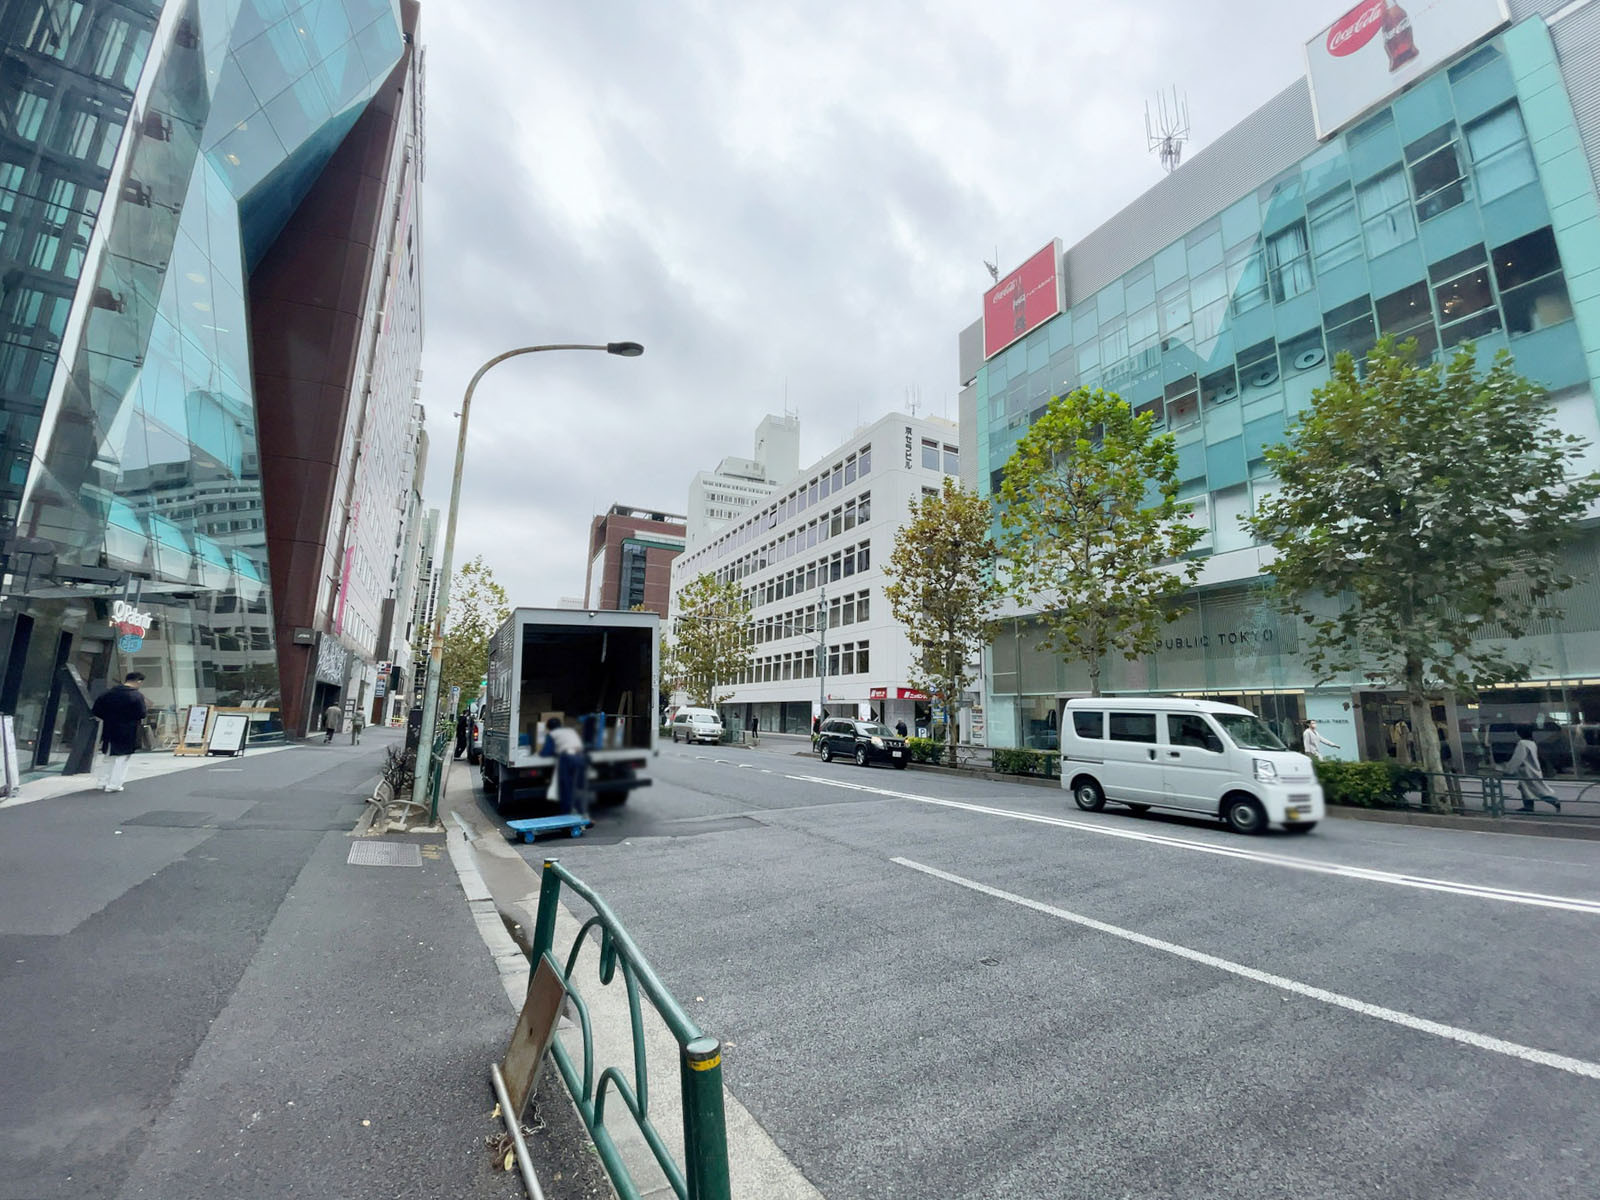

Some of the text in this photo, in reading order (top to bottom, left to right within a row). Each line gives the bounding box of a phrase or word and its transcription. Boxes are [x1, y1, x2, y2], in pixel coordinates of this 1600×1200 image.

[1329, 1, 1383, 50] Coca-Cola
[1155, 629, 1273, 650] PUBLIC TOKYO
